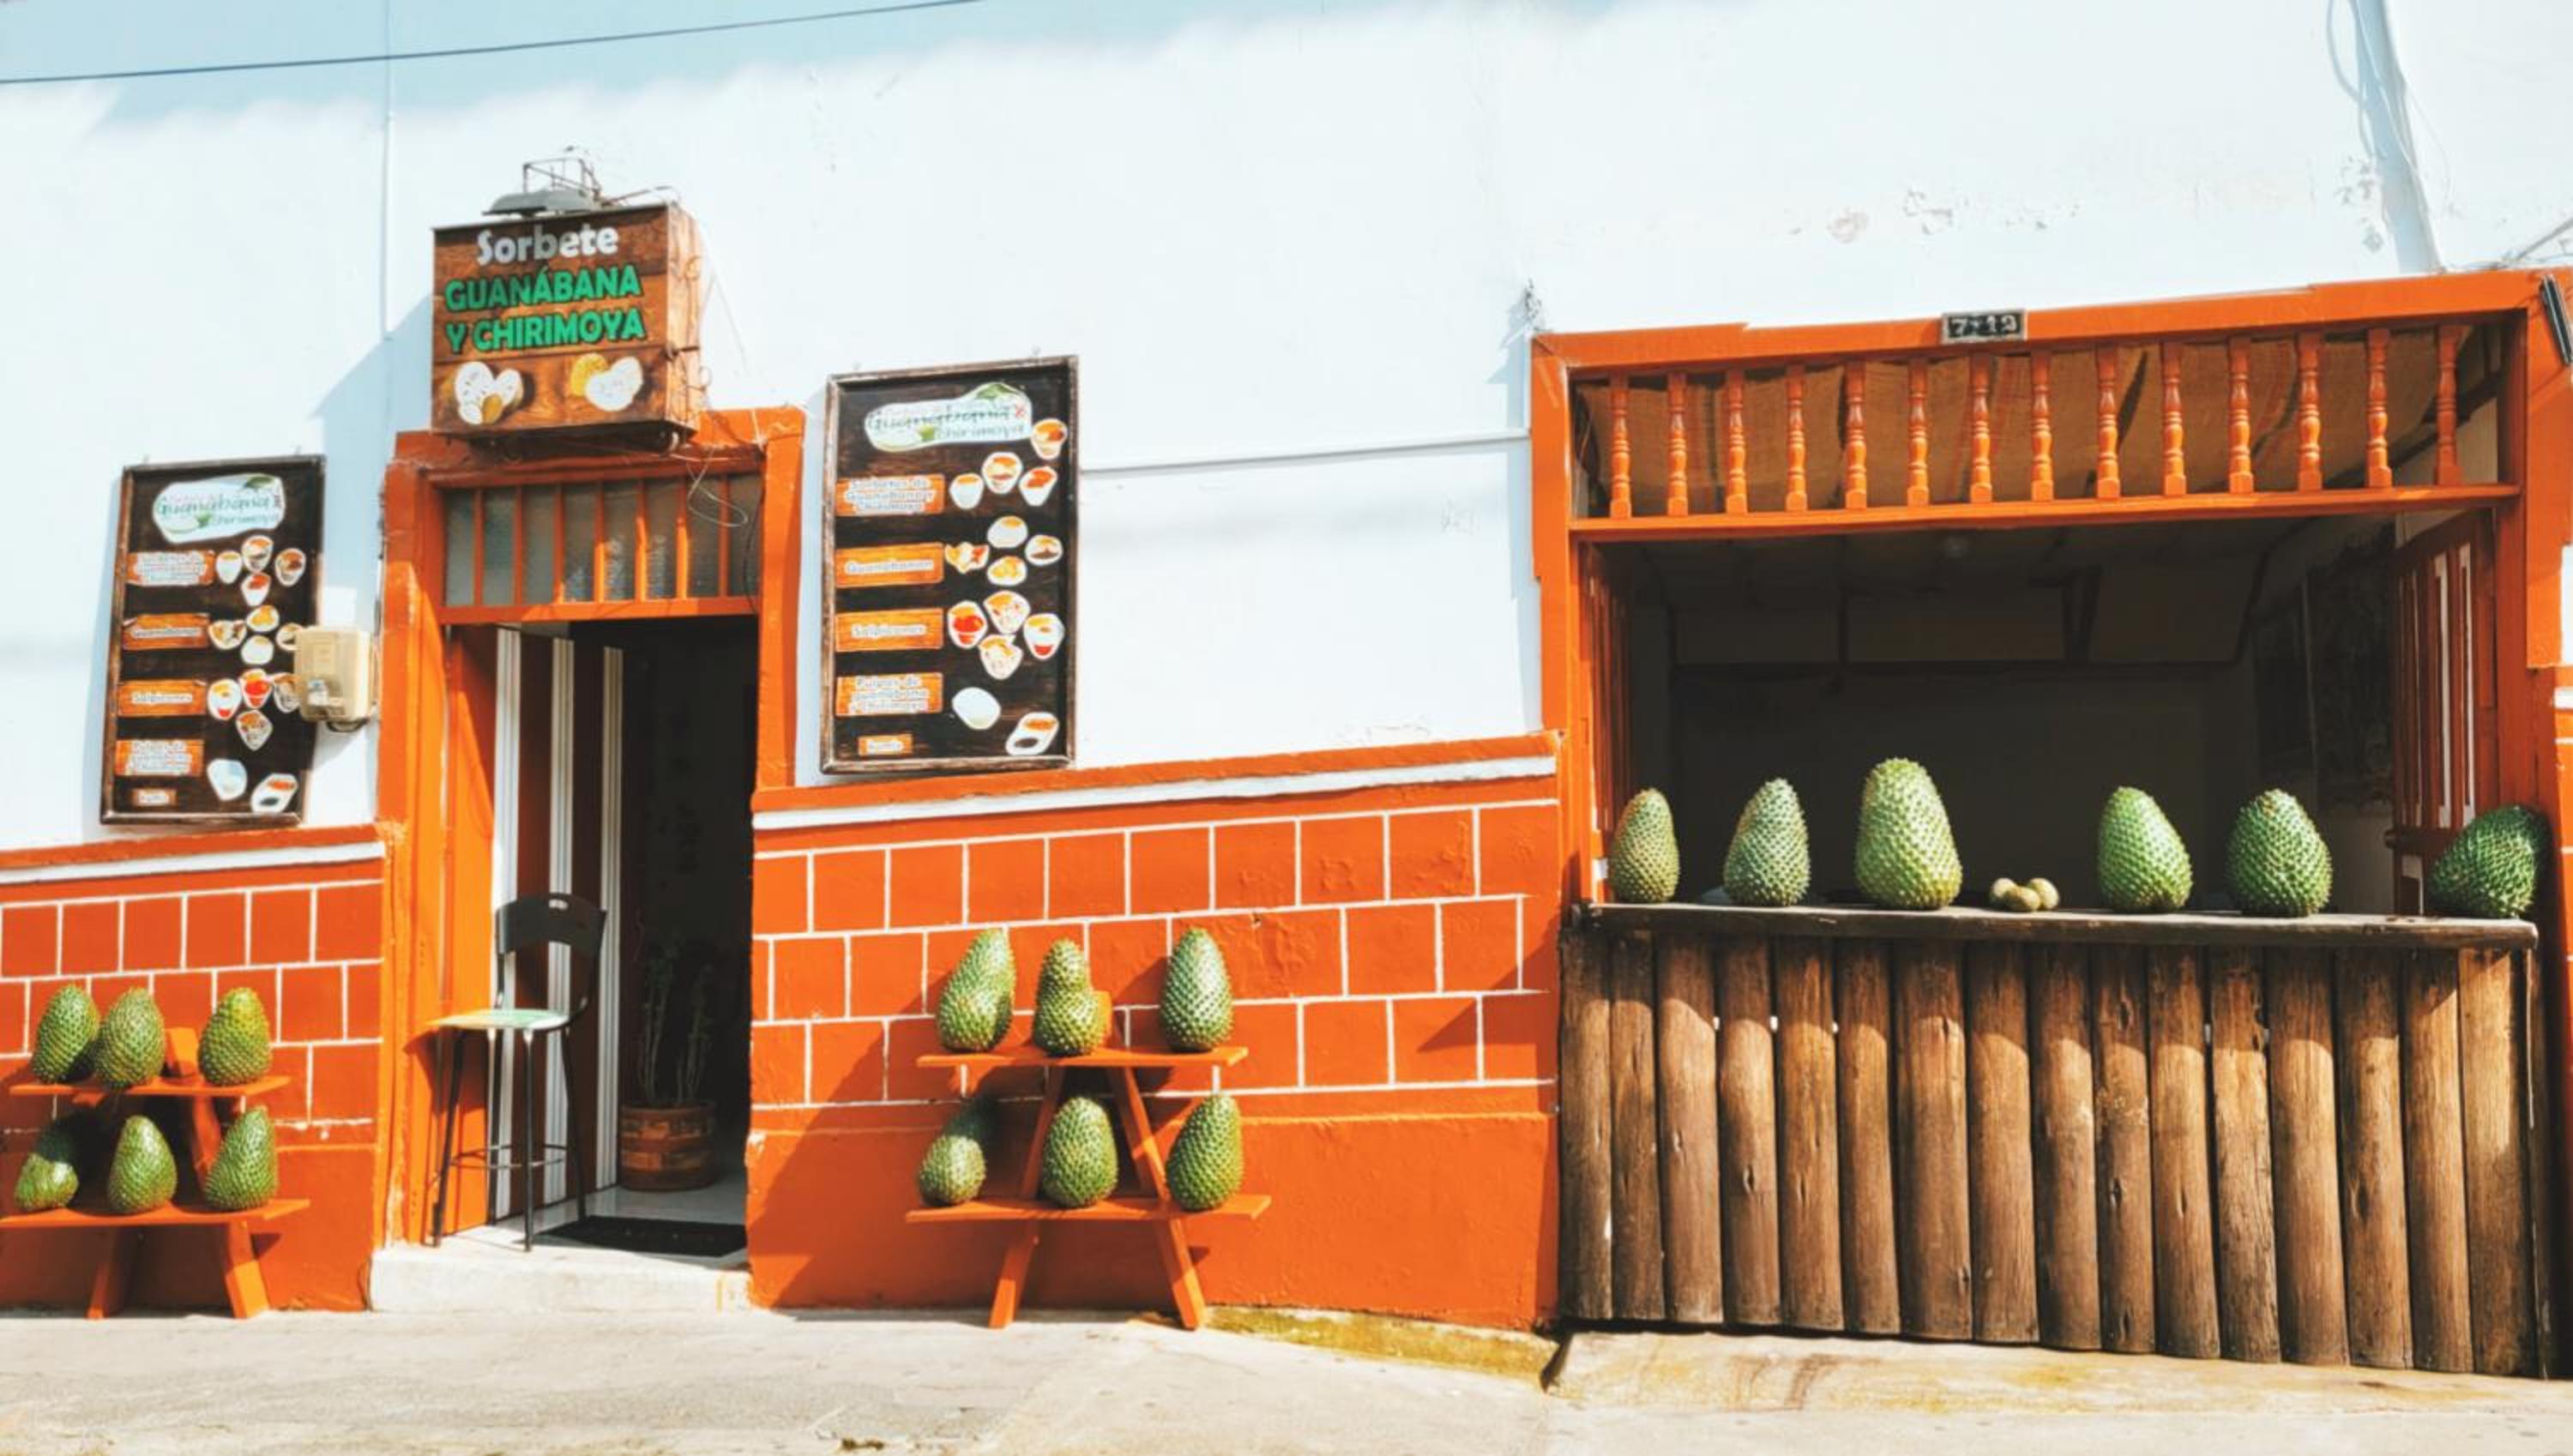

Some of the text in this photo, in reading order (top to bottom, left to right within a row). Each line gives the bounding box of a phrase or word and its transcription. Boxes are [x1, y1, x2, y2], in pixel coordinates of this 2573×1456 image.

[477, 223, 619, 266] Sorbete
[444, 264, 642, 313] GUANÁBANA
[445, 308, 646, 353] Y CHIRIMOYA
